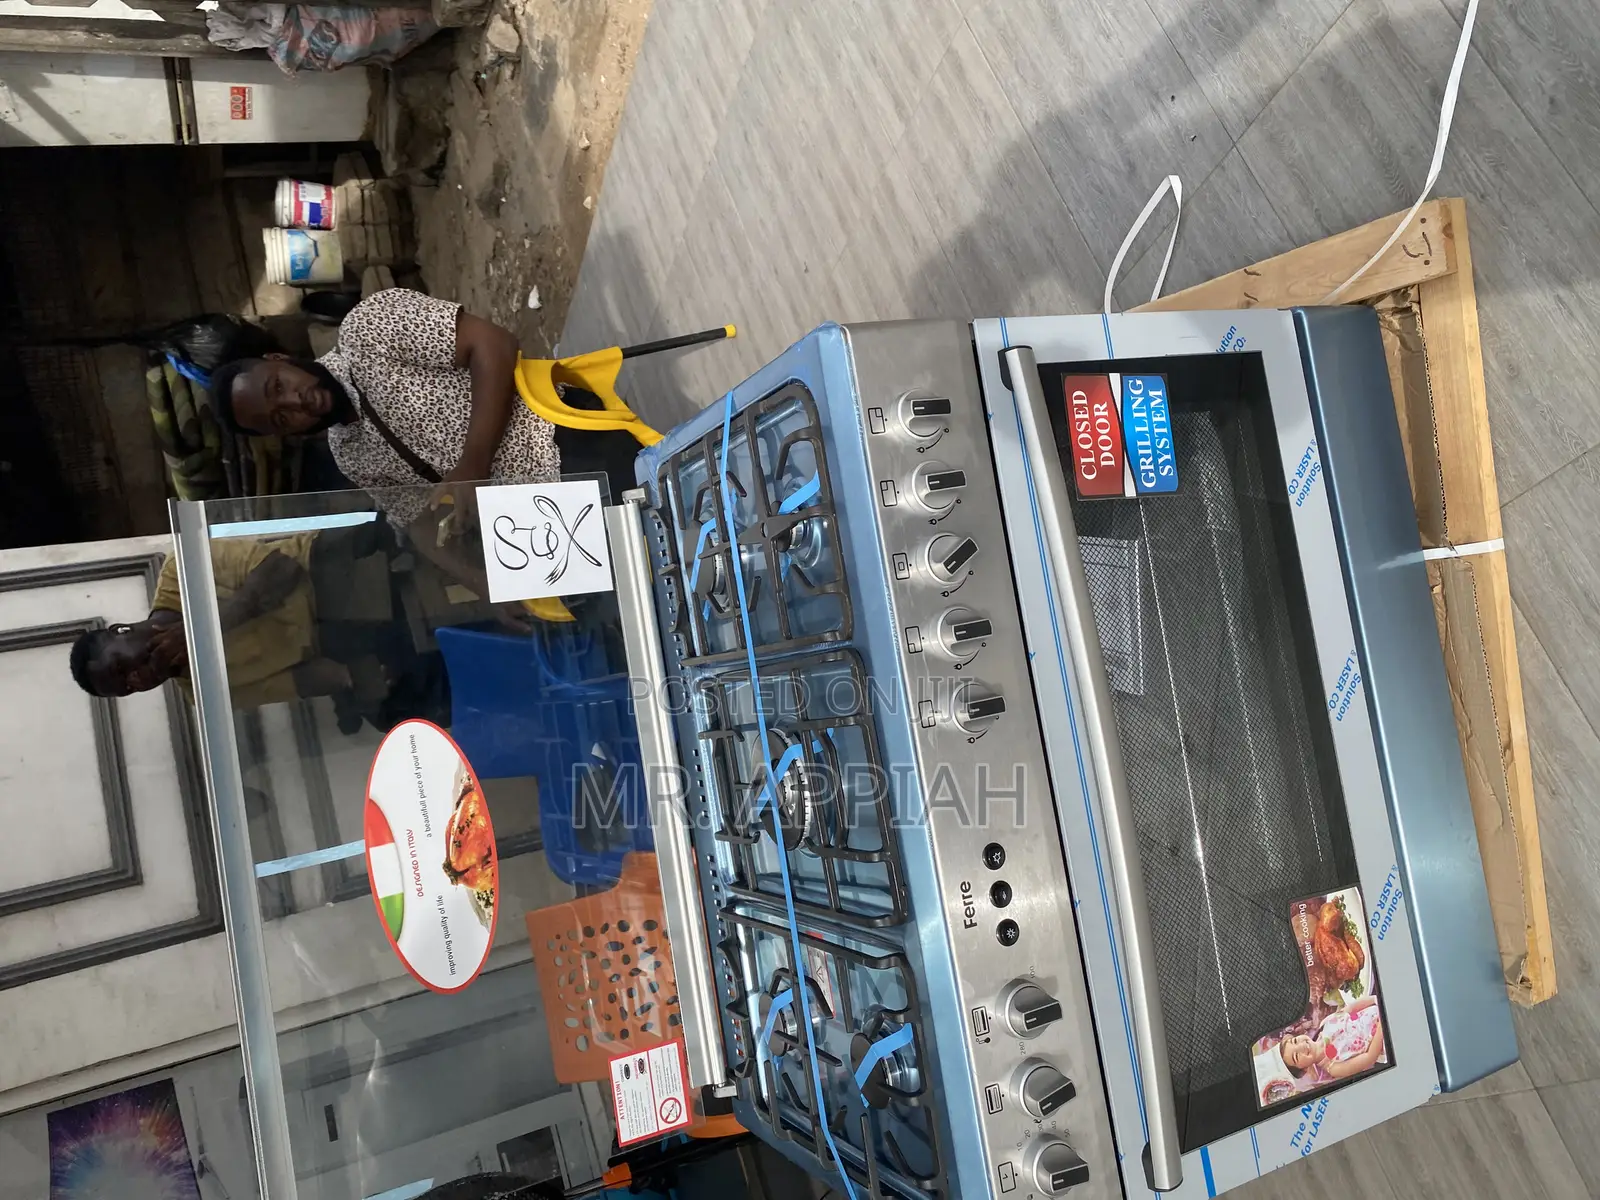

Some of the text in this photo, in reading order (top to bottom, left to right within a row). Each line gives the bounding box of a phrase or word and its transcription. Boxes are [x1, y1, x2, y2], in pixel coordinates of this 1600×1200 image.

[1072, 390, 1098, 480] CLOSED
[1094, 402, 1115, 468] DOOR
[1129, 378, 1157, 488] GRILLING
[1149, 389, 1174, 476] SYSTEM
[1295, 447, 1314, 478] LASER
[1295, 462, 1321, 507] Solution
[1336, 657, 1354, 691] LASER
[1336, 673, 1361, 722] Solution
[410, 734, 418, 754] home
[413, 754, 422, 771] your
[414, 771, 422, 779] of
[417, 780, 426, 799] piece
[419, 799, 432, 832] beautifull
[406, 829, 424, 897] DESIGNED IN ITALY
[959, 880, 978, 929] Ferre
[1377, 873, 1395, 909] LASER
[1298, 903, 1314, 967] better cooking
[1378, 889, 1403, 941] Solution
[436, 895, 457, 976] improving quality of life
[1018, 1041, 1027, 1055] 280
[616, 1080, 625, 1120] ATTENTION!
[1016, 1142, 1023, 1151] 10
[1024, 1129, 1031, 1139] 20
[1290, 1123, 1306, 1147] The
[1301, 1097, 1329, 1156] for LASER
